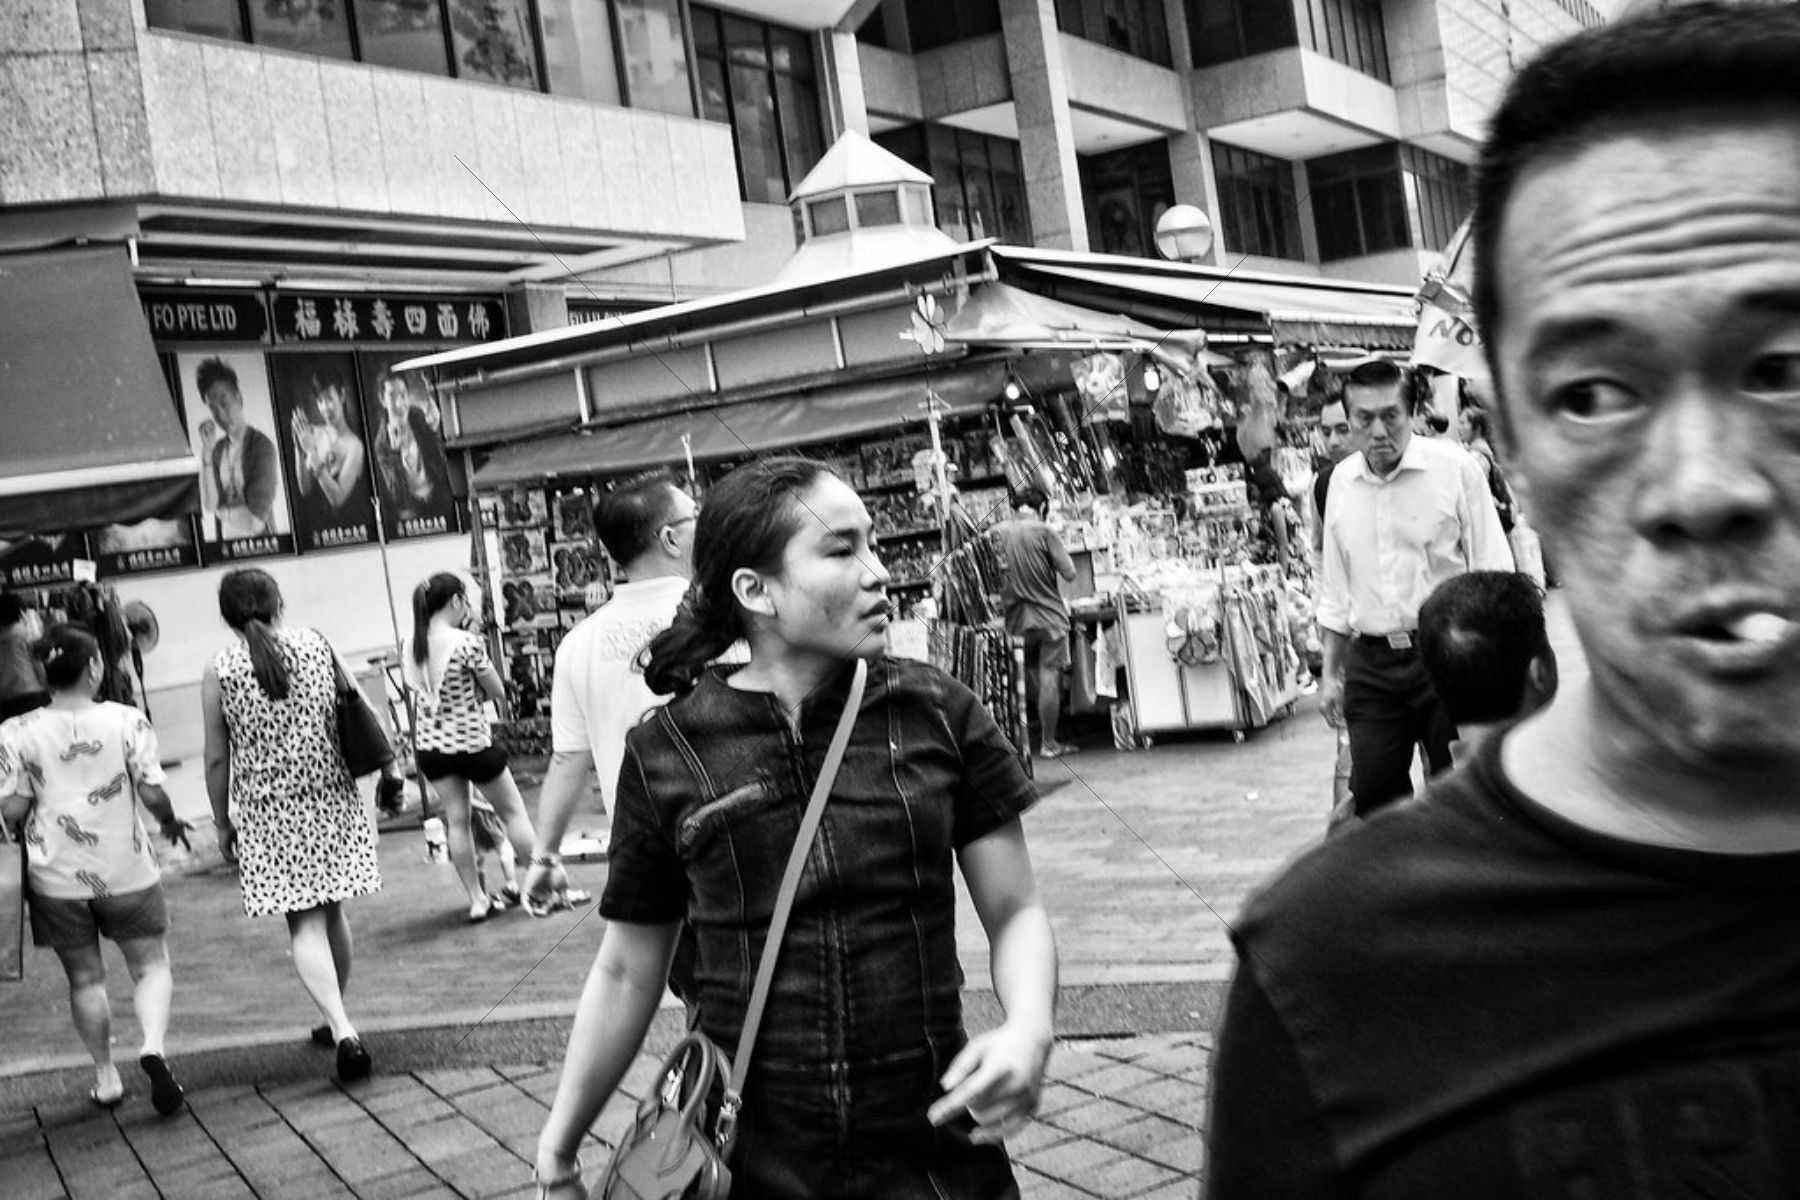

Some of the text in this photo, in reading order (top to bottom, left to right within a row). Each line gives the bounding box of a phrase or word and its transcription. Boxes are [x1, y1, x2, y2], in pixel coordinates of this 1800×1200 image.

[152, 303, 175, 331] FO
[177, 303, 208, 331] PTE
[209, 303, 237, 331] LTD
